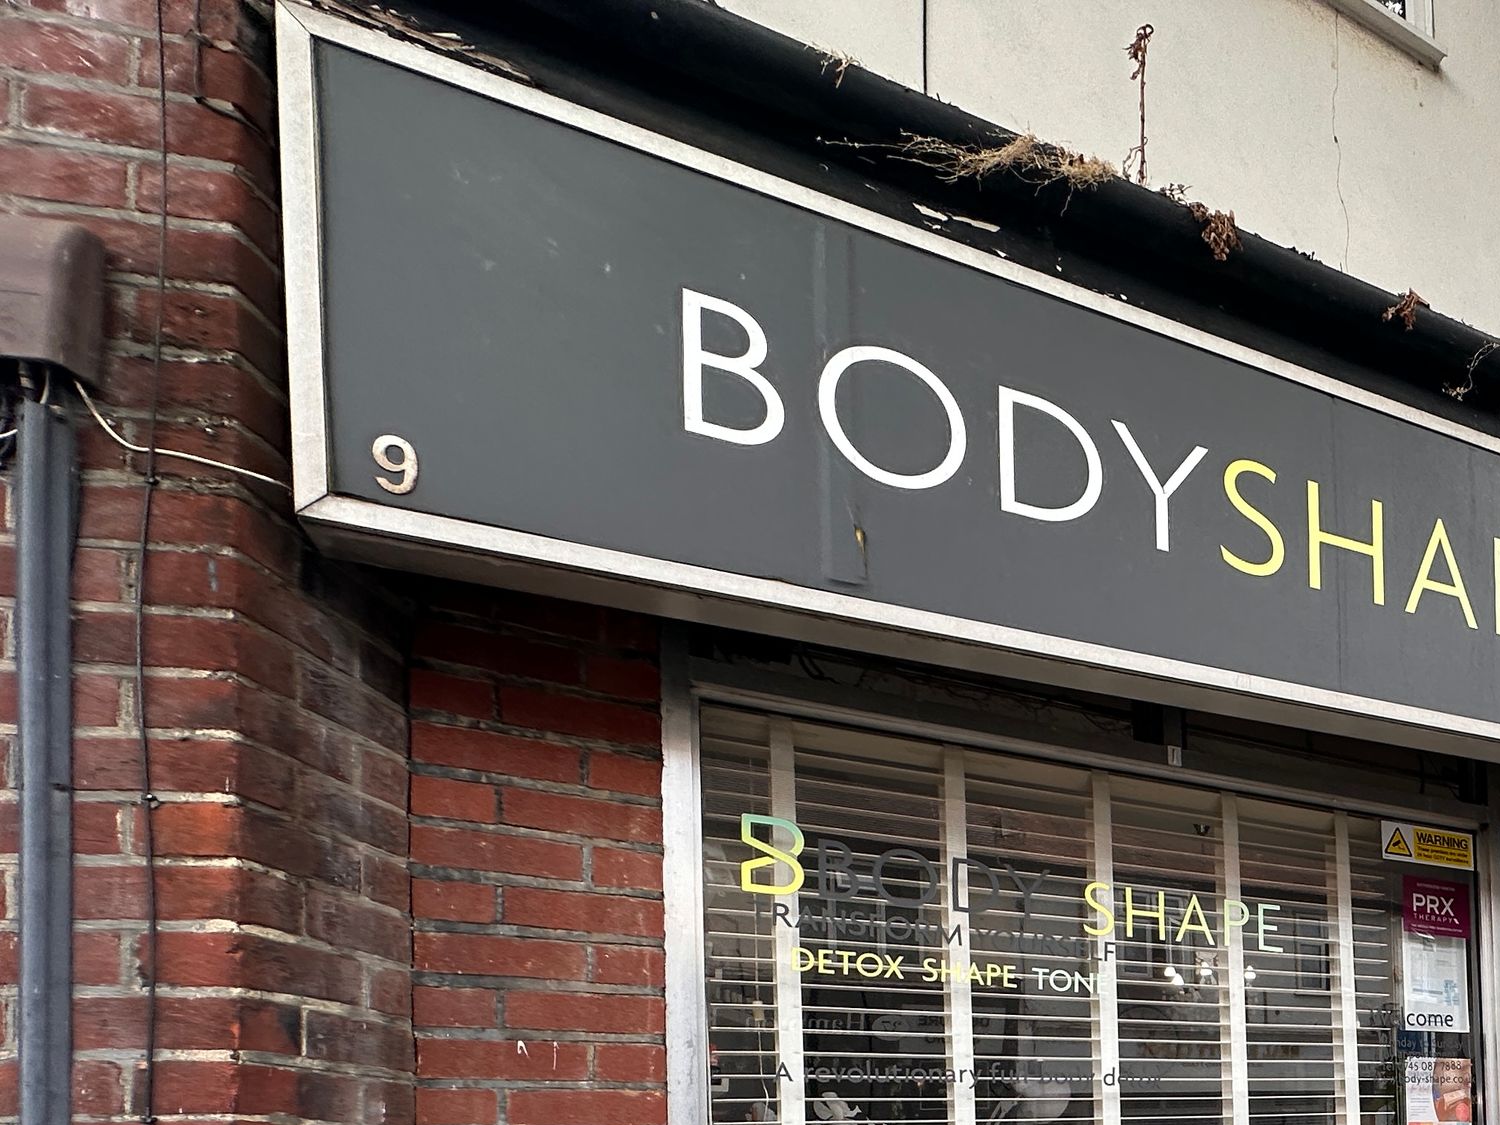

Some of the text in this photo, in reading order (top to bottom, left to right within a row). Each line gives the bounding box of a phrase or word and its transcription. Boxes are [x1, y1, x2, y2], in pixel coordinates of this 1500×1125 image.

[372, 434, 417, 494] 9
[1416, 832, 1469, 849] WARNING
[817, 838, 1284, 953] BODY SHAPE
[1413, 893, 1454, 916] PRX
[1414, 913, 1453, 924] THERAPY
[791, 948, 905, 980] DETOX
[922, 957, 1018, 989] SHAPE
[774, 1062, 793, 1082] A
